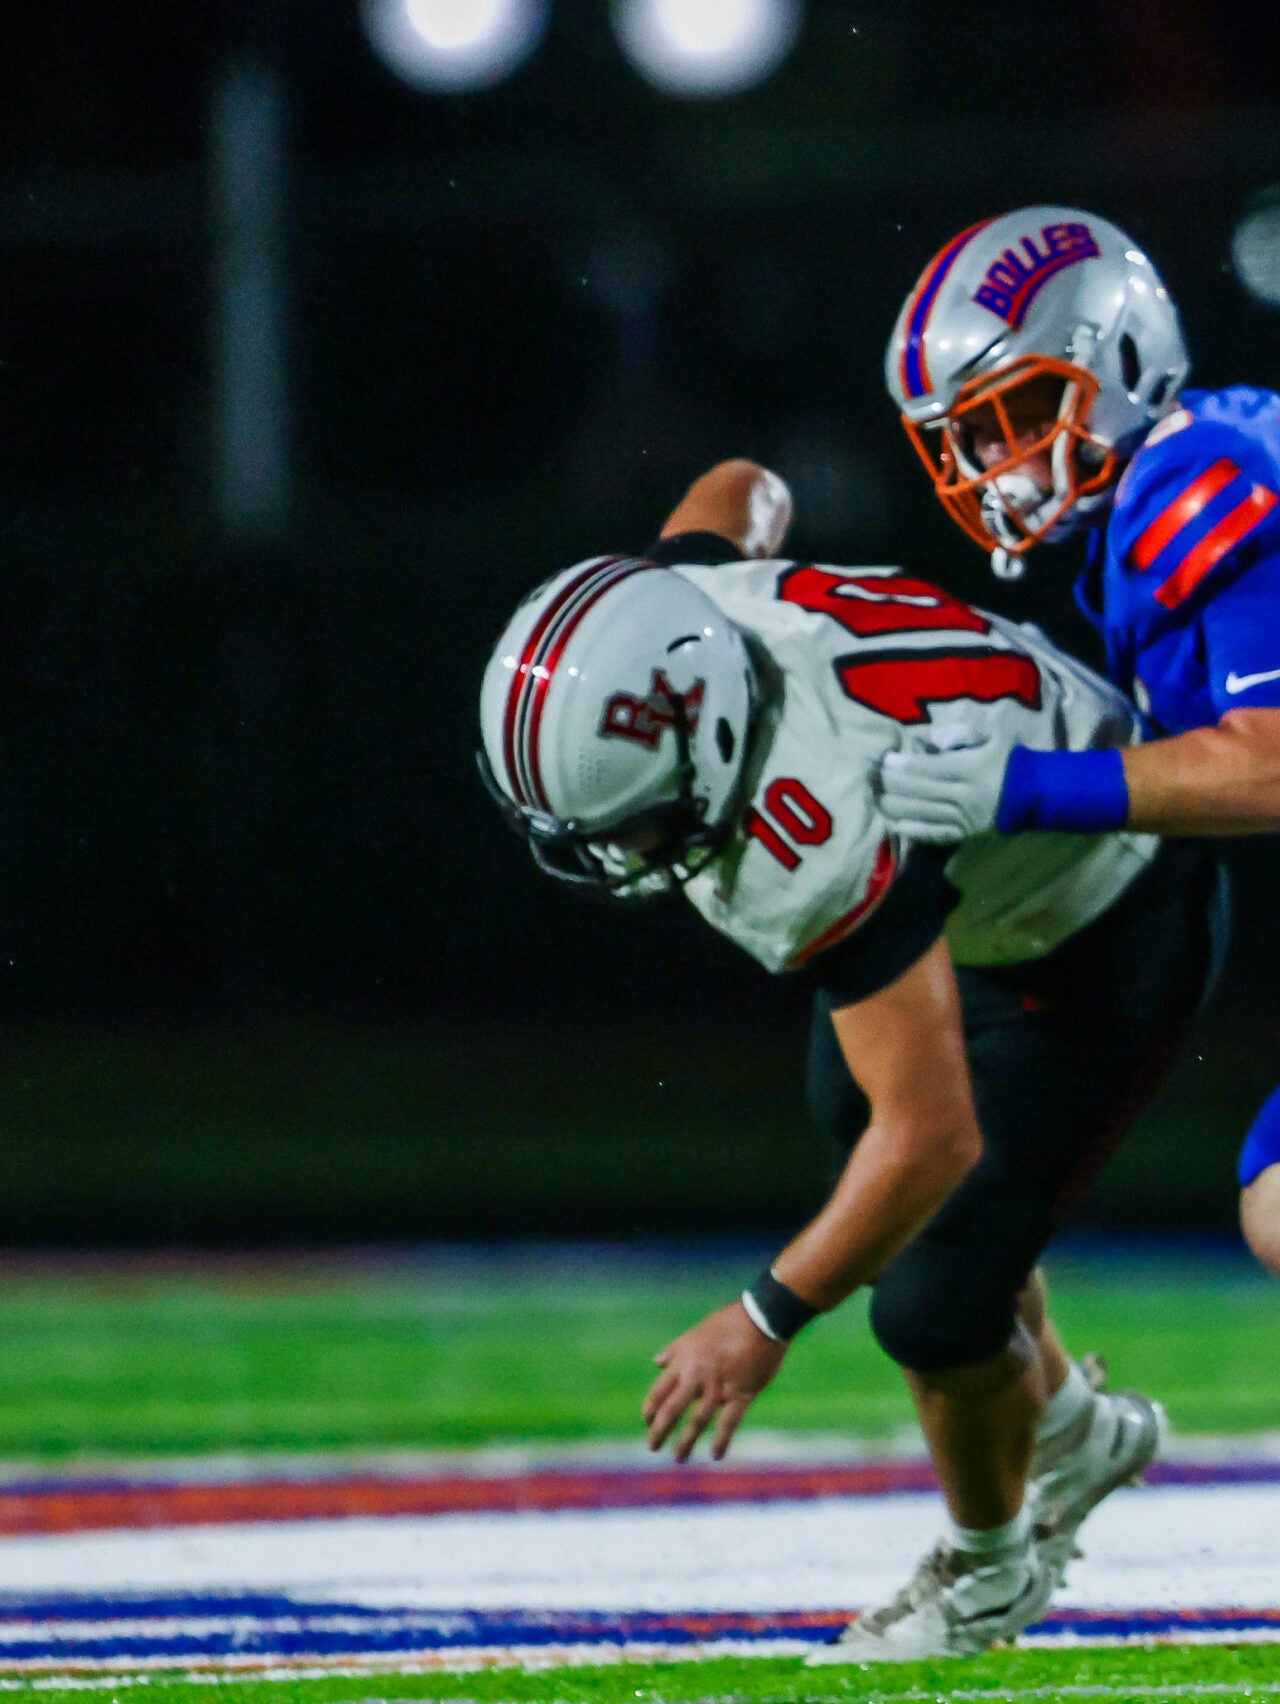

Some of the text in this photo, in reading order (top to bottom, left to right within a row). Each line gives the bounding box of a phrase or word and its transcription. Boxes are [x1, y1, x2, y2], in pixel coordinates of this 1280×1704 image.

[972, 222, 1100, 324] BOLLES
[776, 562, 1042, 725] 10
[748, 778, 833, 871] 10
